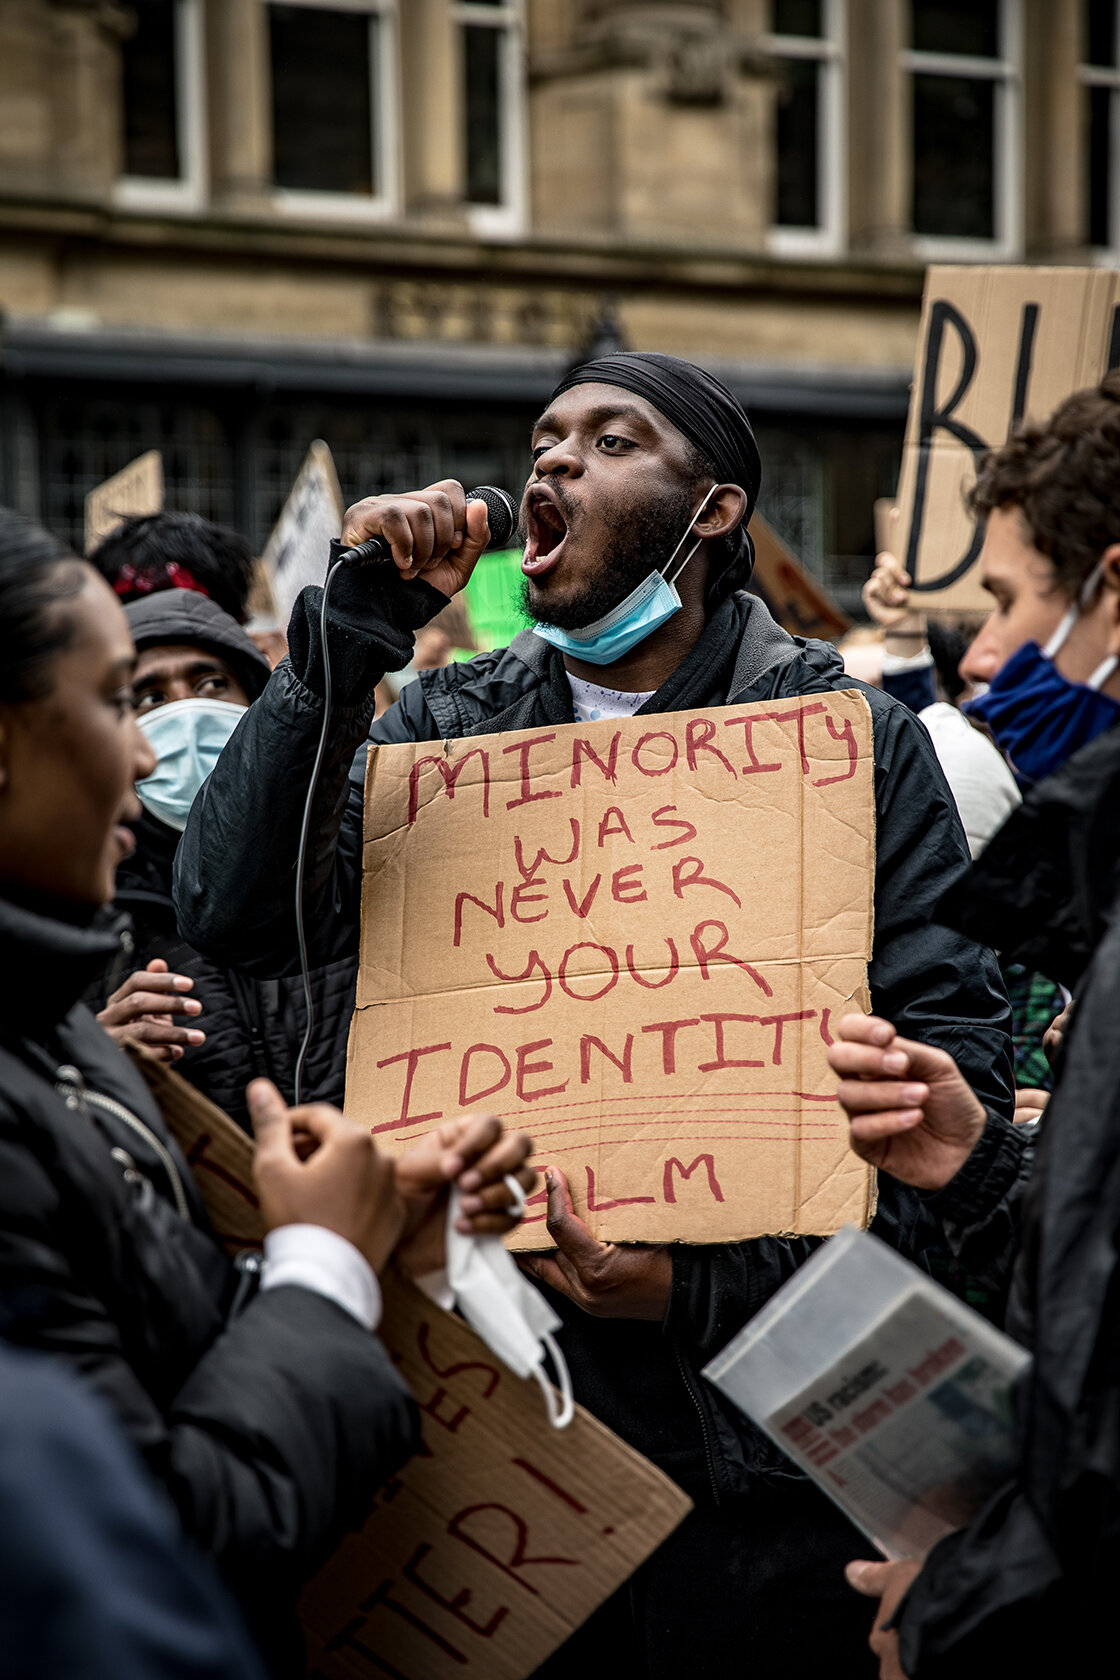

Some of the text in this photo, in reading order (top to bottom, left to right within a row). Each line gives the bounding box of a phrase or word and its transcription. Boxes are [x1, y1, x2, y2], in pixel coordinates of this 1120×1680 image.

[408, 701, 858, 825] MINORITY
[513, 804, 697, 876] WAS
[453, 856, 742, 947] NEVER
[485, 919, 774, 1015] YOUR
[311, 1457, 616, 1680] TTER!
